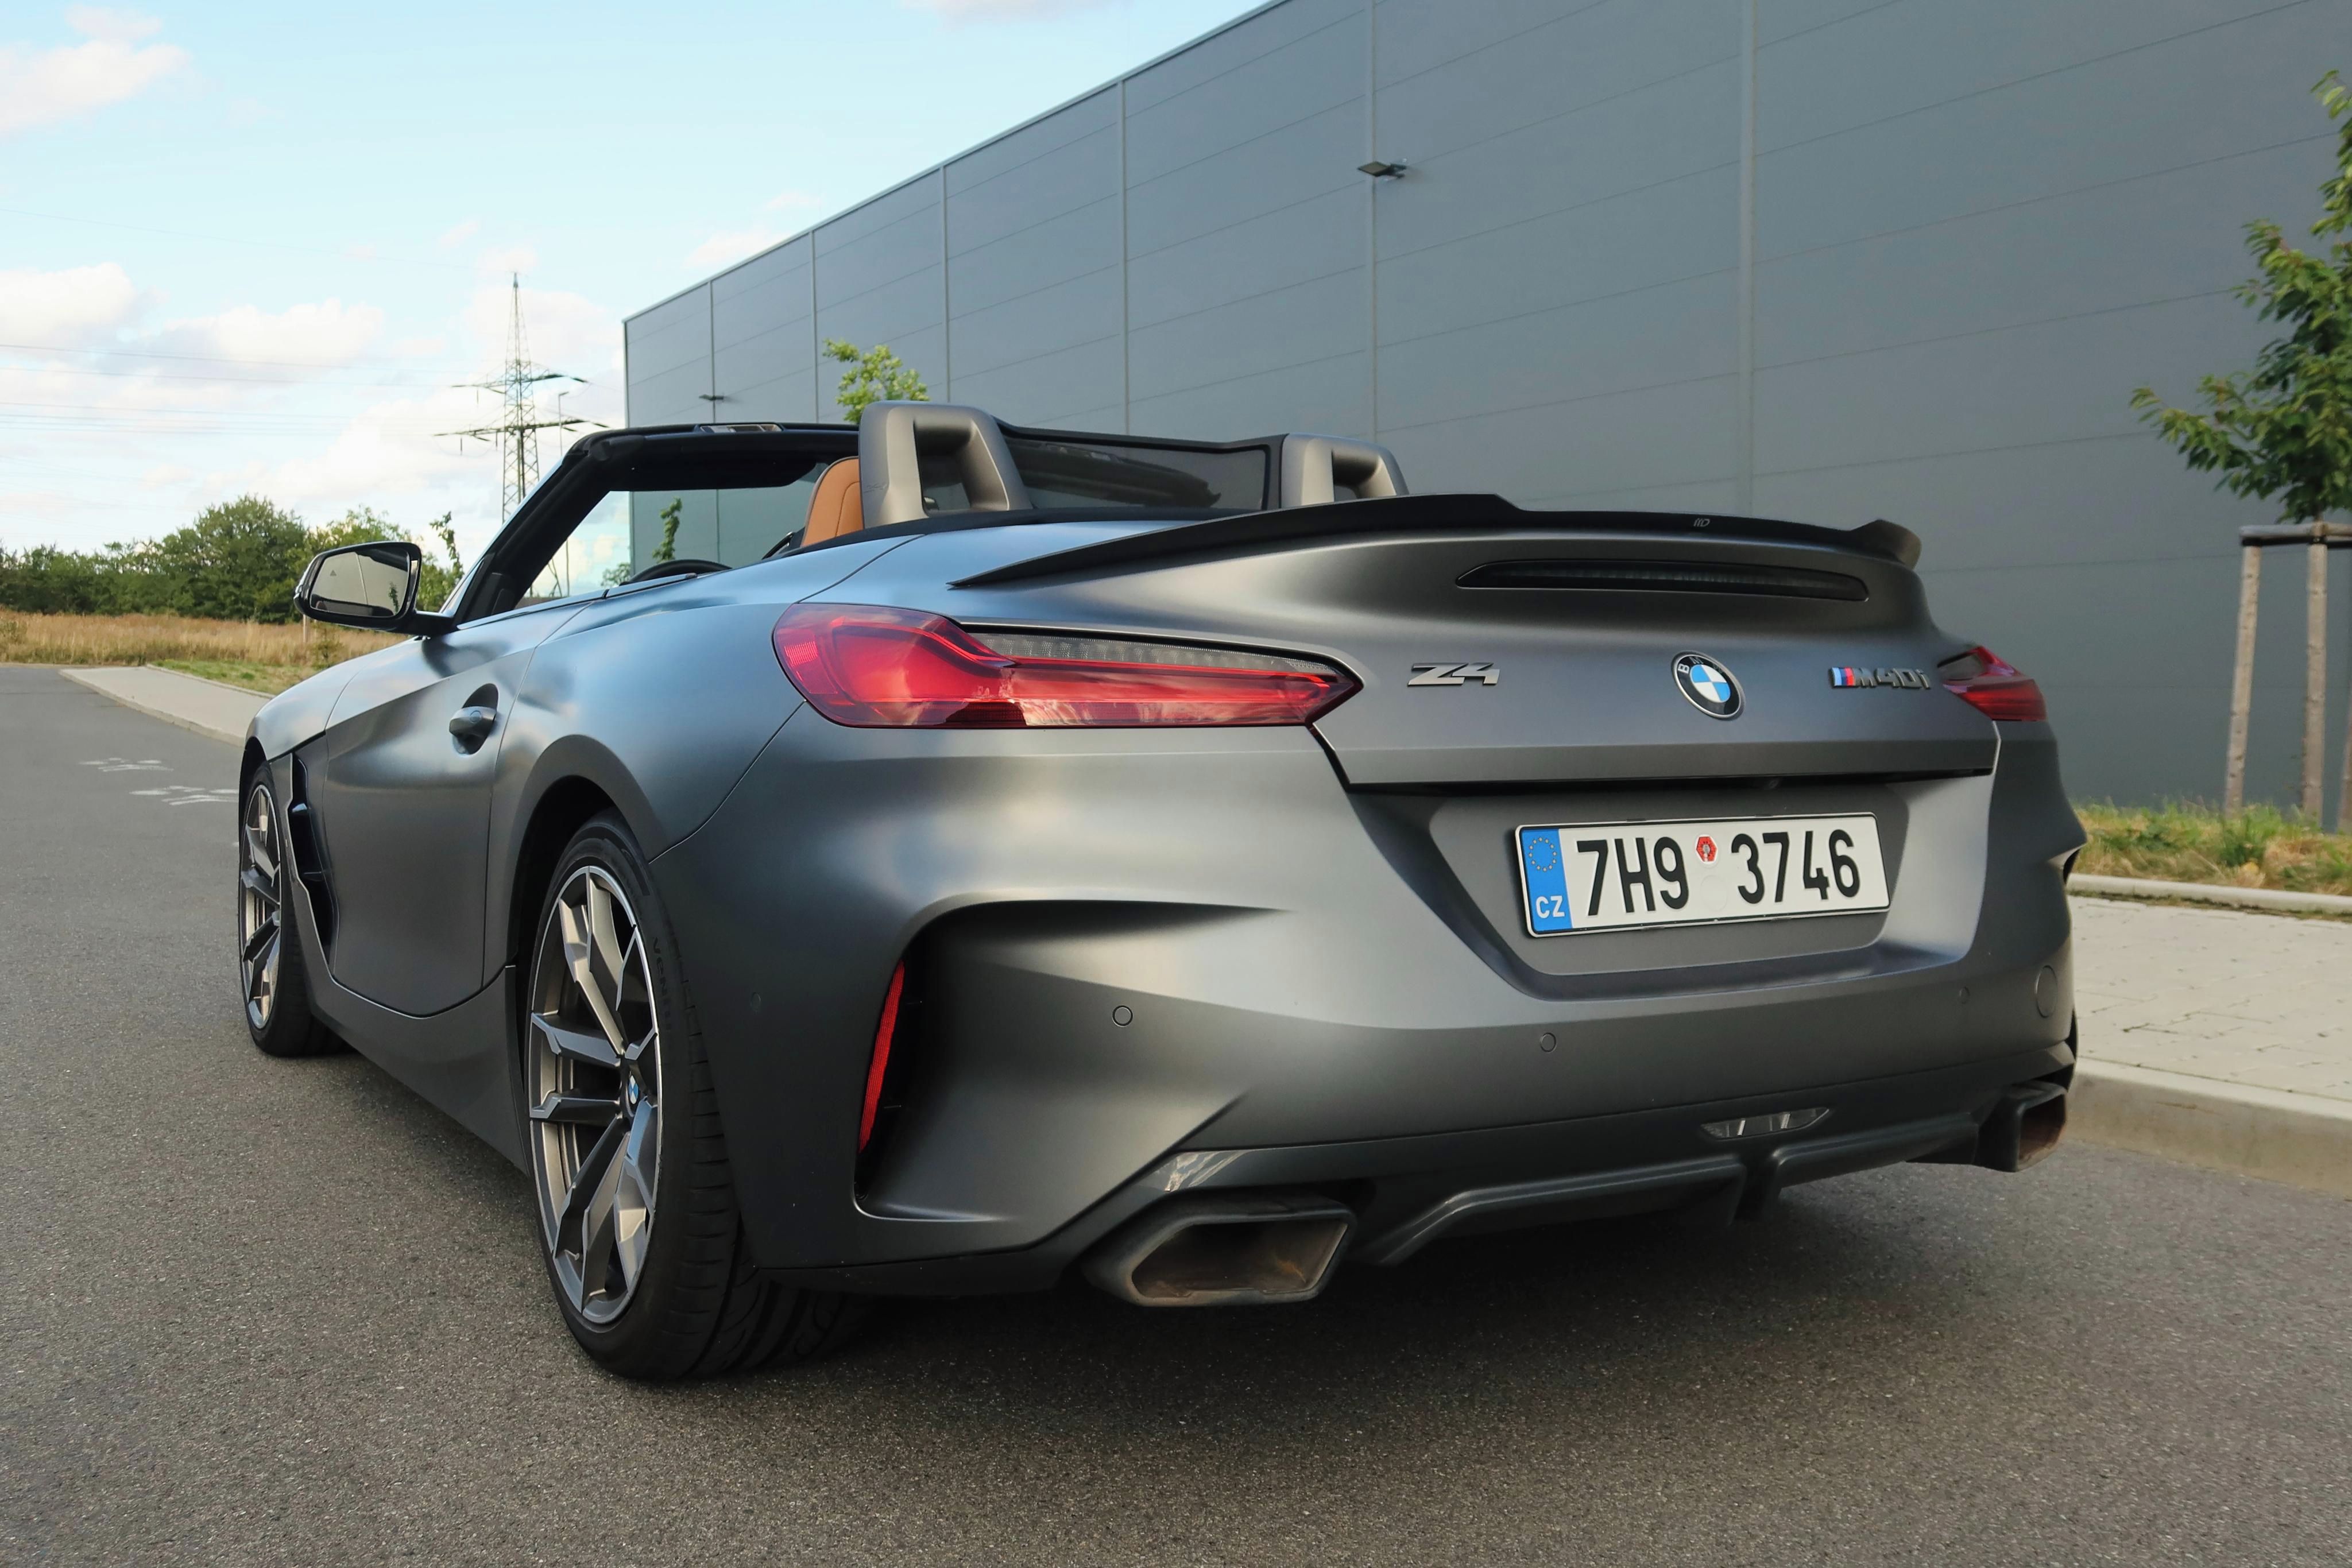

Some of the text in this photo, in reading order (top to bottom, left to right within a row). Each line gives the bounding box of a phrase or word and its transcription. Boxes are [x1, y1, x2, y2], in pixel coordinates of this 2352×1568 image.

[1407, 663, 1500, 686] Z4
[1576, 829, 1860, 917] 7H9 3746
[1535, 895, 1566, 919] CZ
